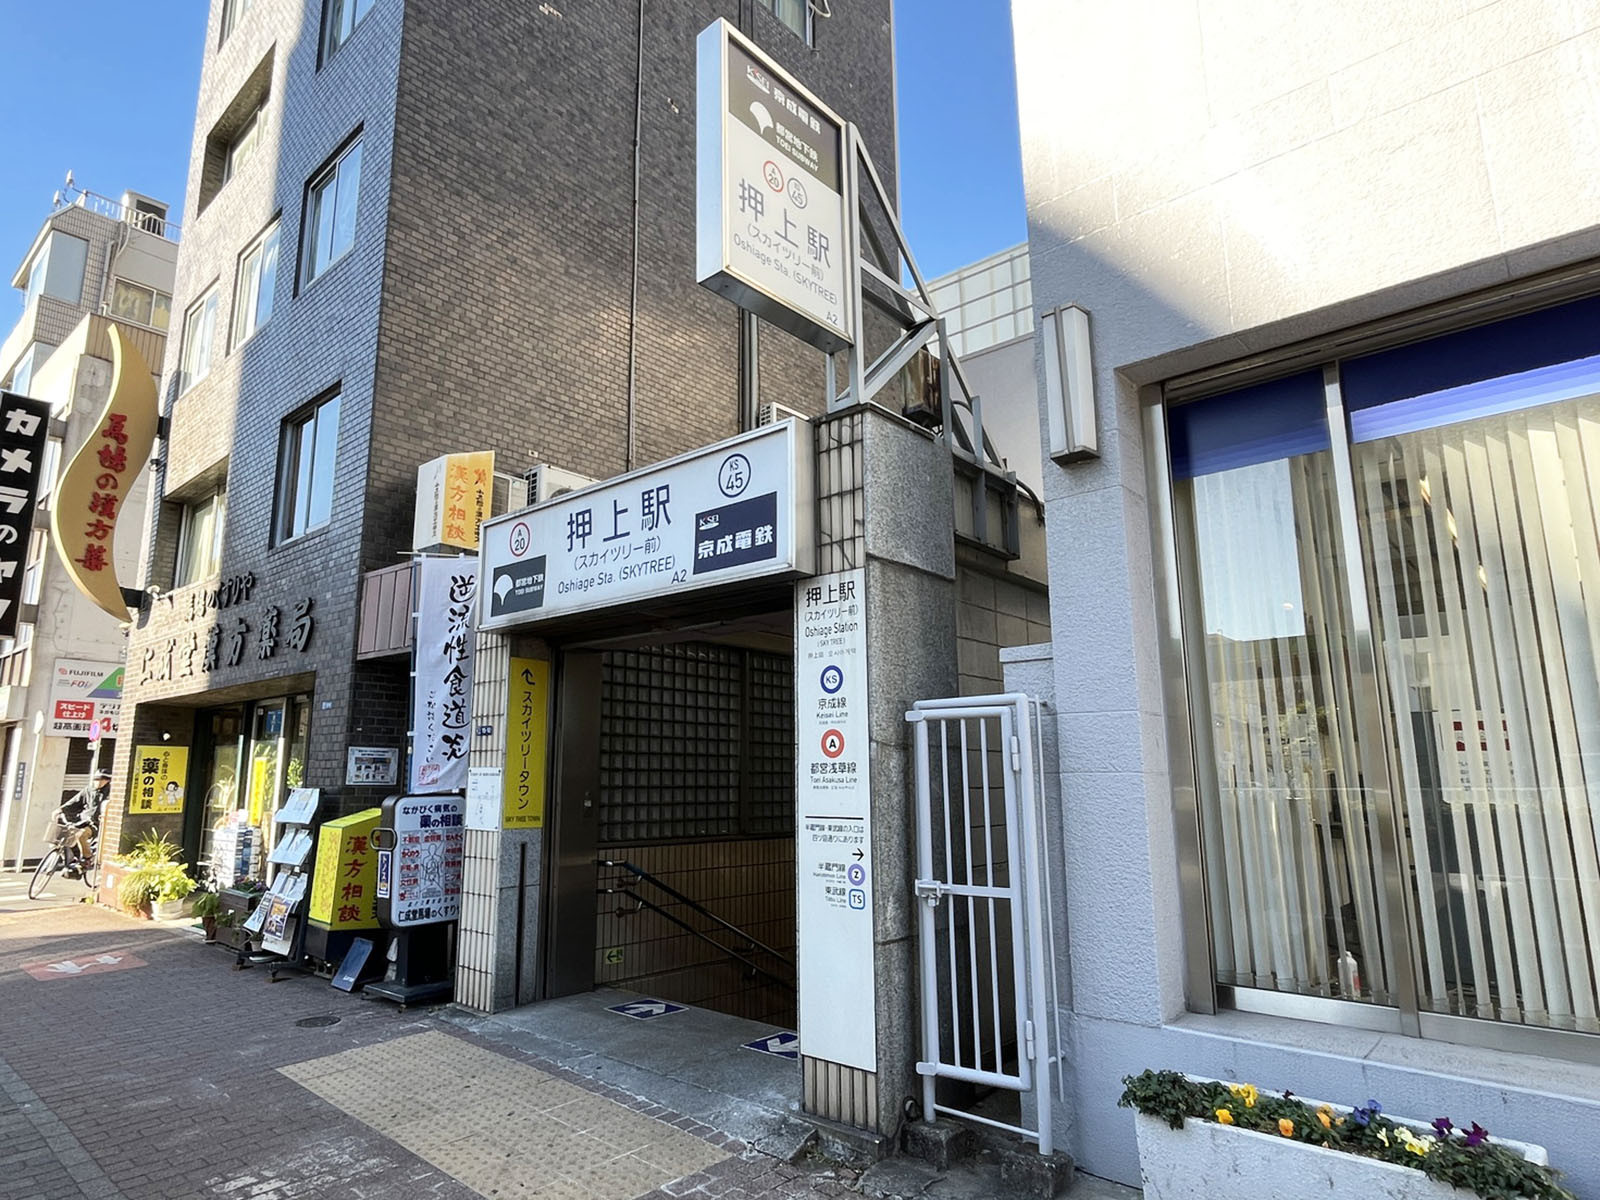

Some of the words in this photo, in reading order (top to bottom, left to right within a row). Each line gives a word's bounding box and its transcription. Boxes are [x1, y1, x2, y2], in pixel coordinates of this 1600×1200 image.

[774, 87, 821, 135] 京成電鉄
[776, 135, 792, 152] TOEI
[791, 147, 819, 172] SUBWAY
[769, 173, 779, 188] 20
[792, 191, 803, 205] 45
[739, 178, 831, 269] 押上駅
[734, 233, 772, 266] Oshiage
[774, 258, 791, 278] Sta.
[793, 270, 838, 306] (SKYTREE)
[826, 311, 839, 326] A2
[729, 459, 739, 471] KS
[725, 471, 743, 491] 45
[446, 463, 469, 543] 漢方相談
[567, 484, 672, 553] 押上駅
[517, 529, 522, 538] A
[514, 537, 525, 551] 20
[697, 524, 773, 559] 京成電鉄
[574, 535, 661, 572] （スカイツリー前）
[558, 577, 595, 595] Oshiage
[597, 572, 616, 586] Sta.
[619, 555, 676, 581] (SKYTREE)
[671, 569, 688, 585] A2
[806, 580, 855, 608] 押上駅
[804, 625, 832, 639] Oshiage
[833, 621, 858, 635] Station
[69, 669, 103, 677] FUJIFILM
[442, 574, 475, 762] 逆流性食道炎
[825, 674, 838, 684] KS
[60, 703, 90, 711] スピード
[818, 697, 847, 710] 京成線
[62, 710, 86, 719] 仕上げ
[816, 711, 834, 719] Keisei
[517, 691, 533, 811] スカイツリータウン
[829, 739, 837, 749] A
[810, 762, 857, 775] 都営浅草線
[141, 757, 160, 809] 薬の相談
[810, 776, 821, 784] Toei
[845, 776, 857, 784] Line
[420, 814, 463, 828] 薬の相談
[338, 835, 368, 922] 漢方相談
[853, 870, 859, 879] Z
[852, 894, 862, 904] TS
